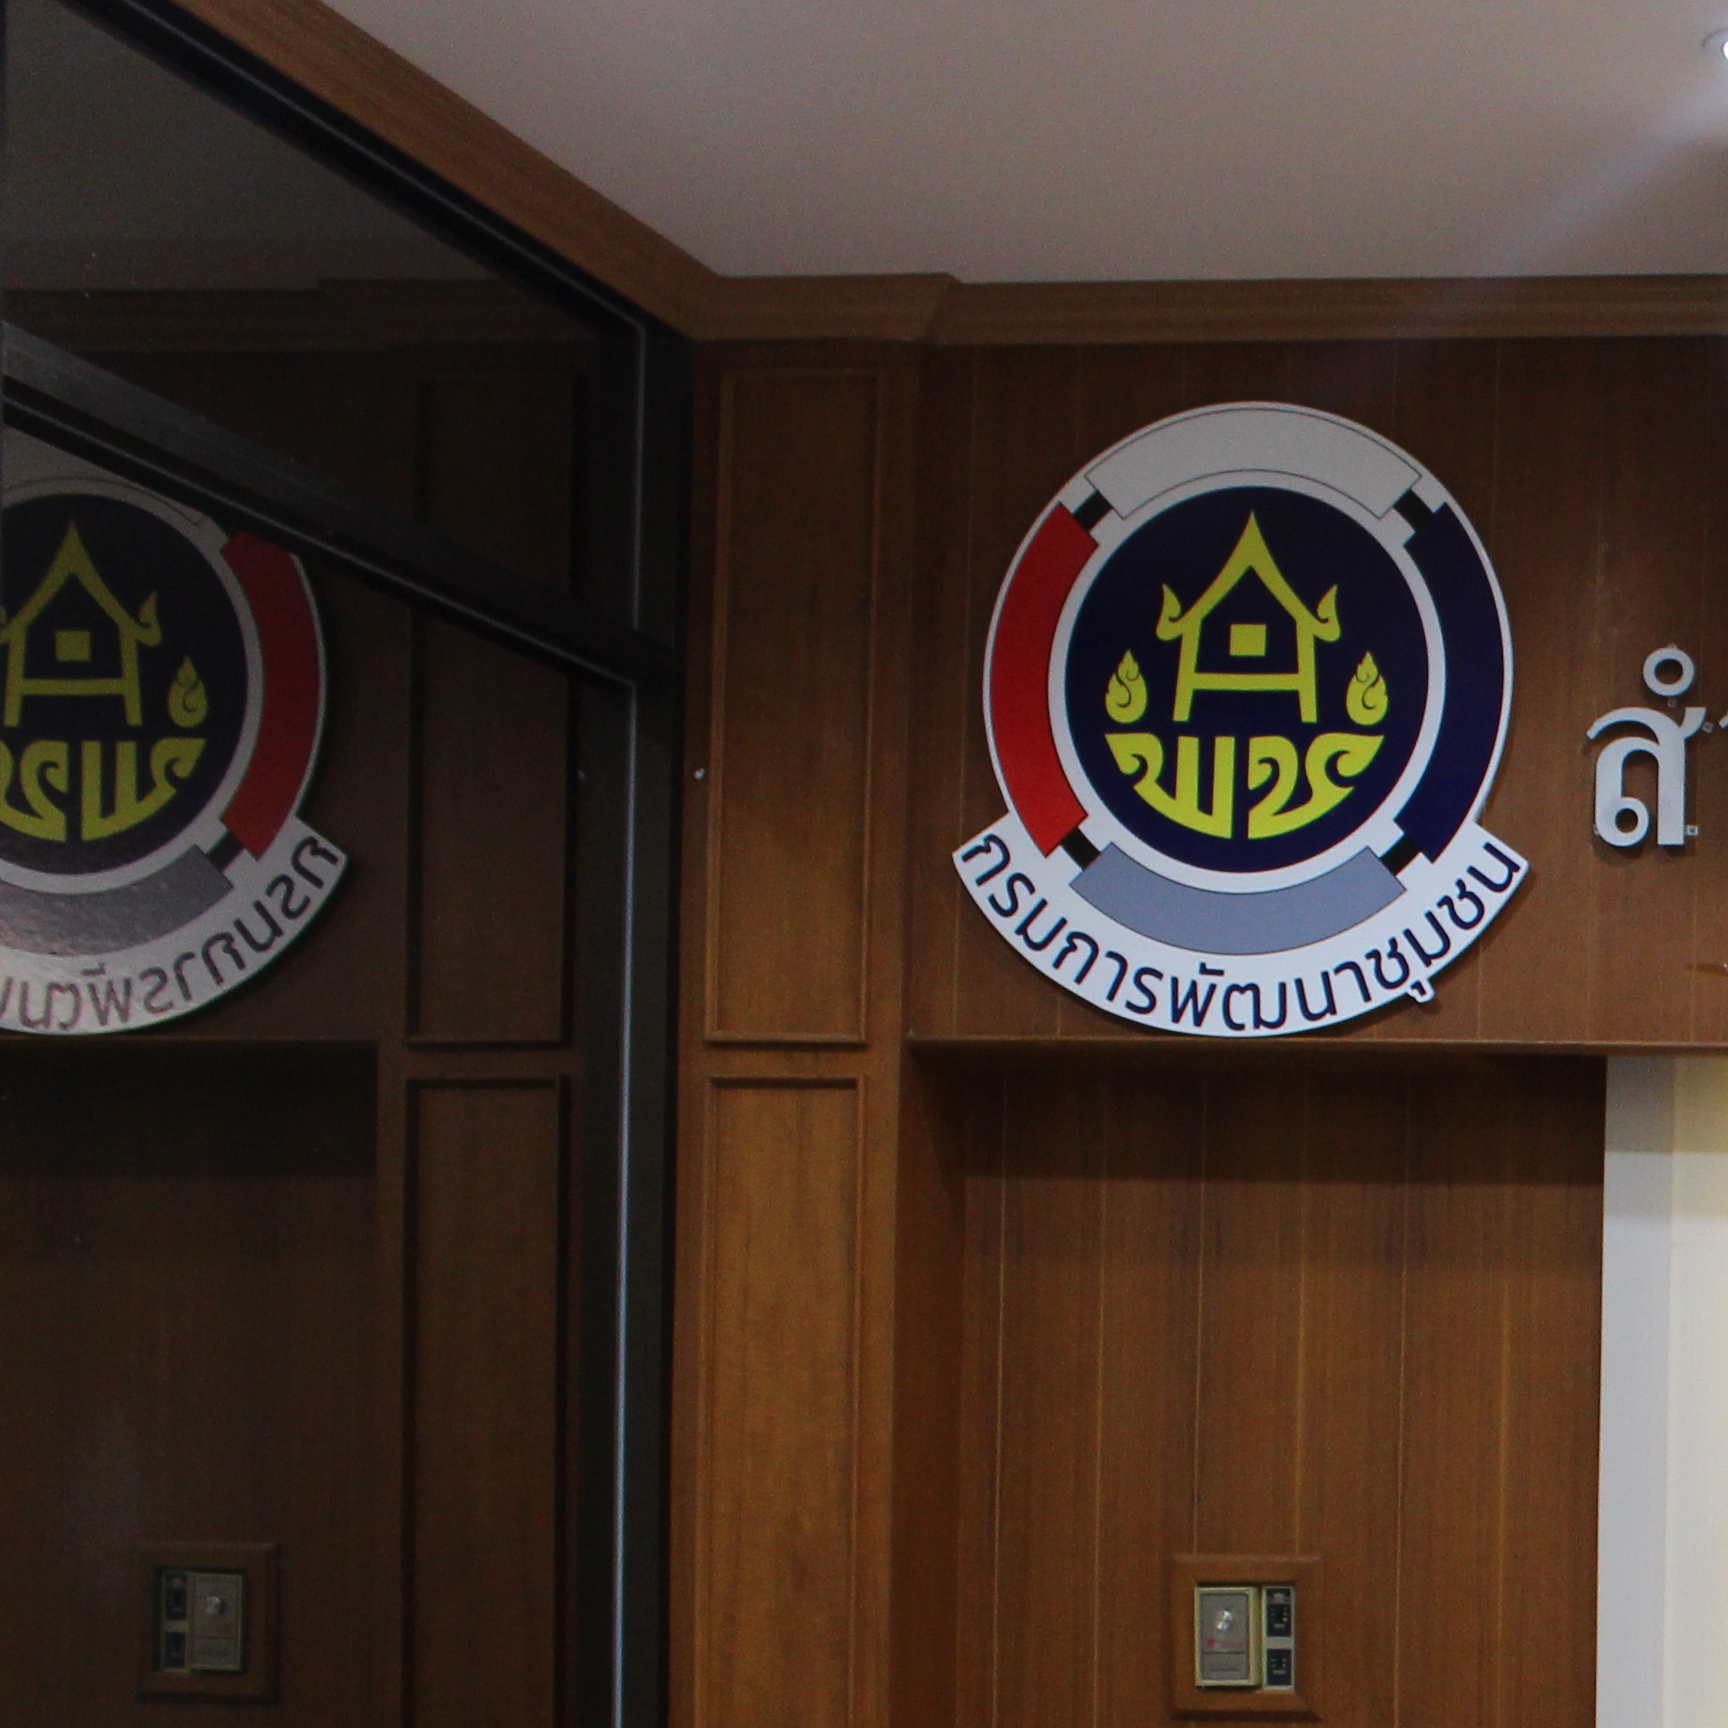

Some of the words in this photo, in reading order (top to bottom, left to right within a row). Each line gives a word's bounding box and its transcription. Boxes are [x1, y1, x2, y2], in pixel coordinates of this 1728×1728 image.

[960, 832, 1521, 1031] กรมการพัฒนาชุมชน
